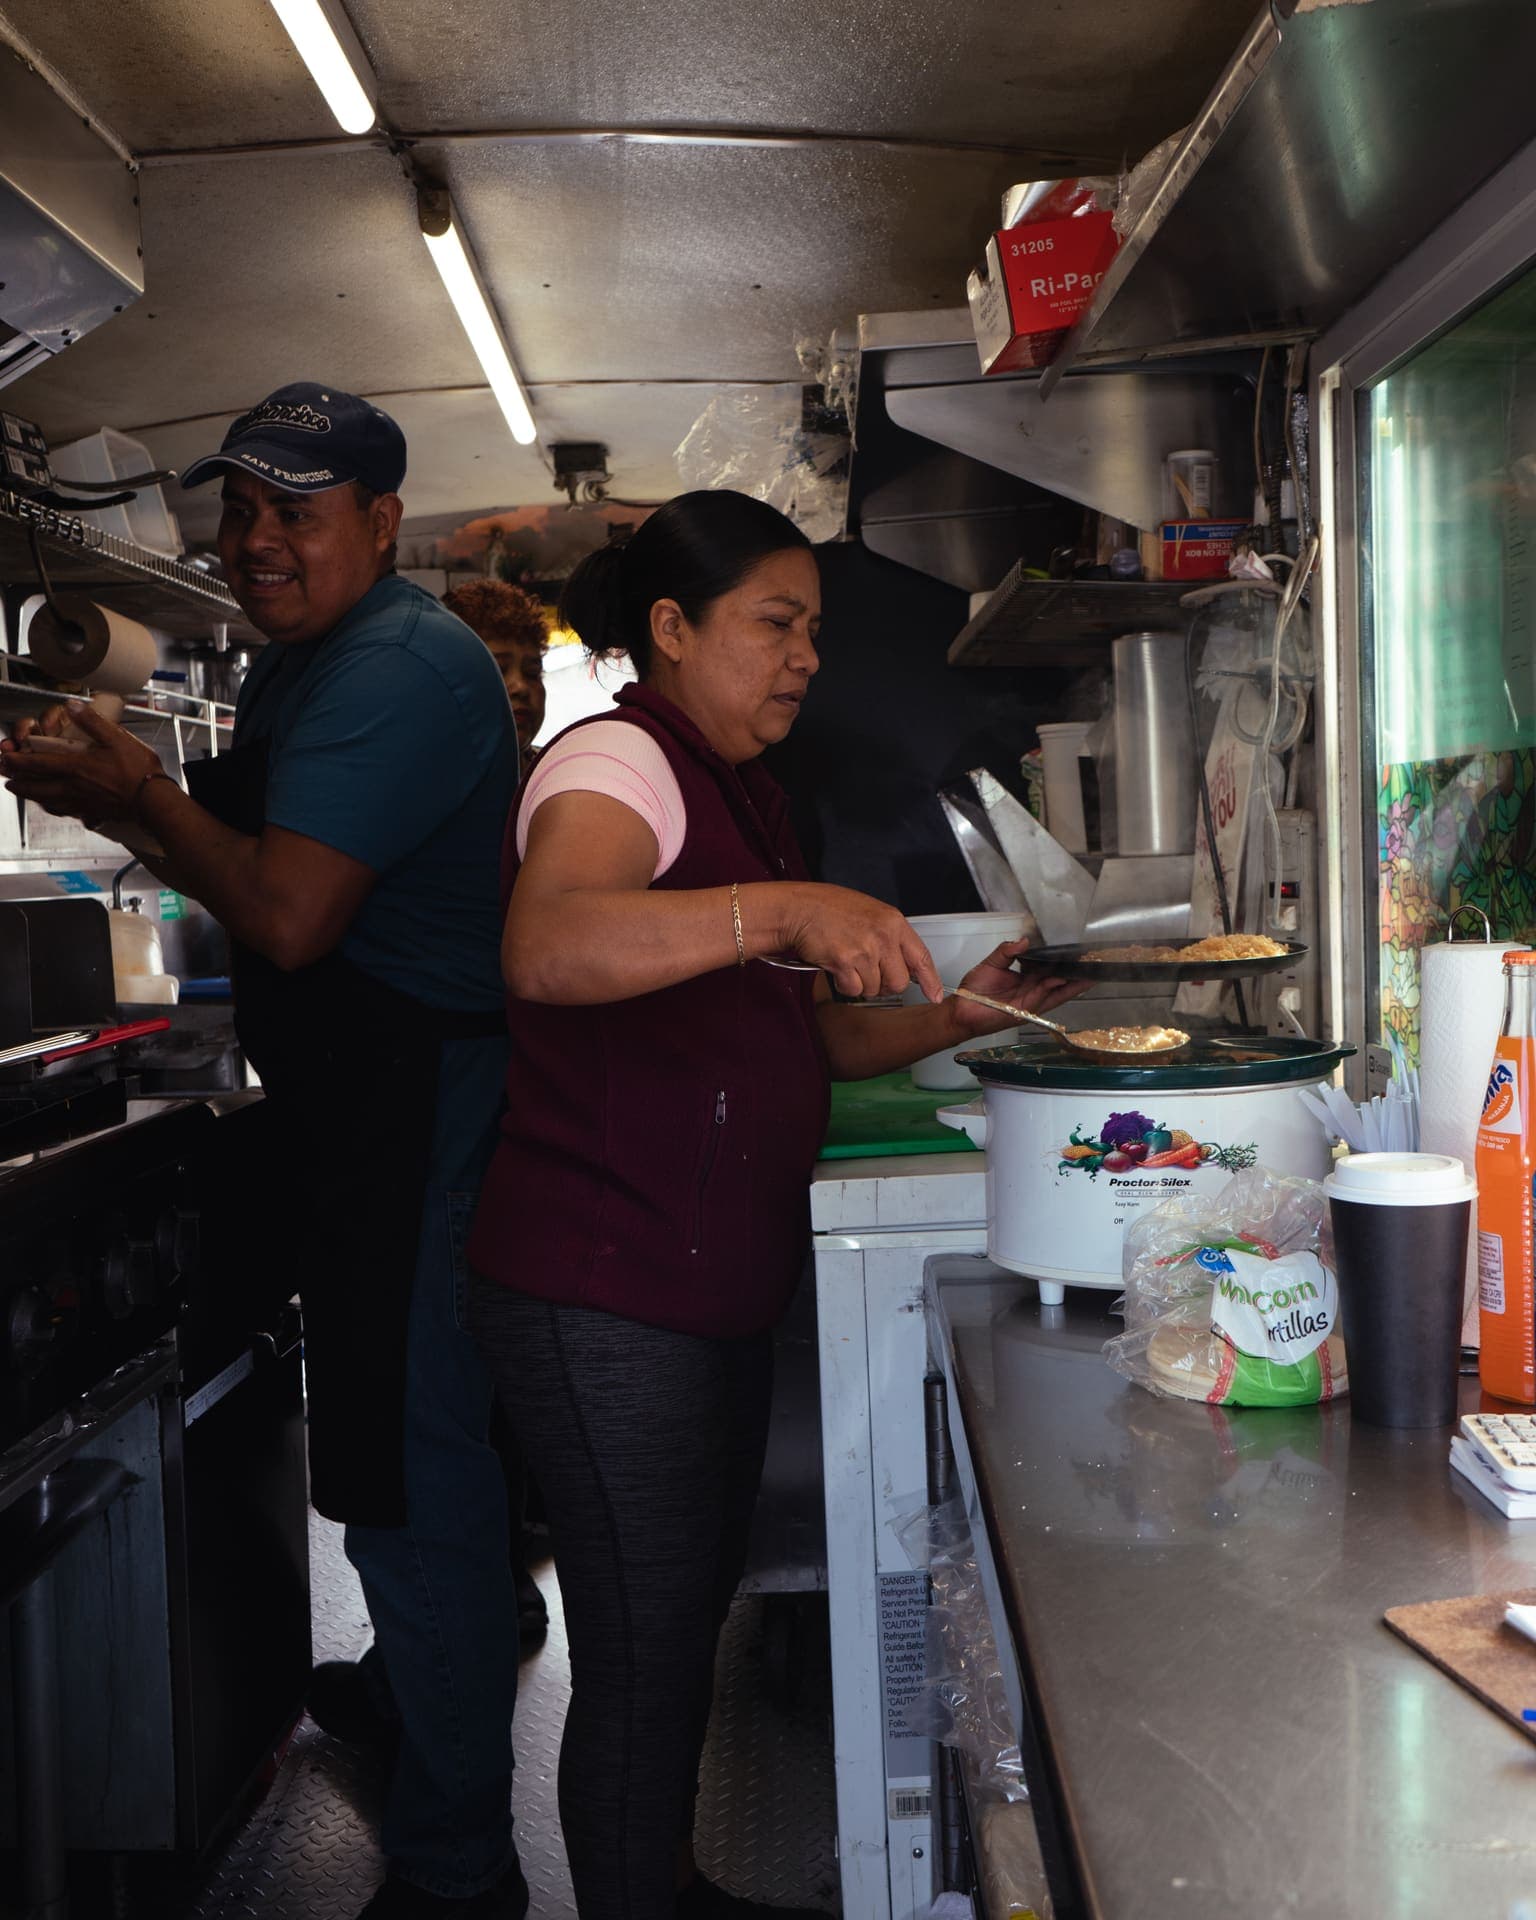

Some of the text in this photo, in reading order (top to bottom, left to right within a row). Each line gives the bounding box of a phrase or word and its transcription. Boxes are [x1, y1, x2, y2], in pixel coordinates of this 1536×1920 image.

[1011, 238, 1054, 257] 31205
[241, 454, 334, 484] SAN FRANCISCO
[1185, 549, 1202, 557] BOX
[1113, 1217, 1124, 1225] Off
[881, 1586, 919, 1598] Refrigerant
[881, 1599, 908, 1608] Service
[882, 1610, 892, 1619] Do
[893, 1609, 907, 1618] Not
[883, 1630, 922, 1642] Refrigerant
[884, 1643, 905, 1652] Guide
[886, 1675, 915, 1685] Property
[888, 1708, 903, 1717] Due
[889, 1719, 906, 1728] Follo
